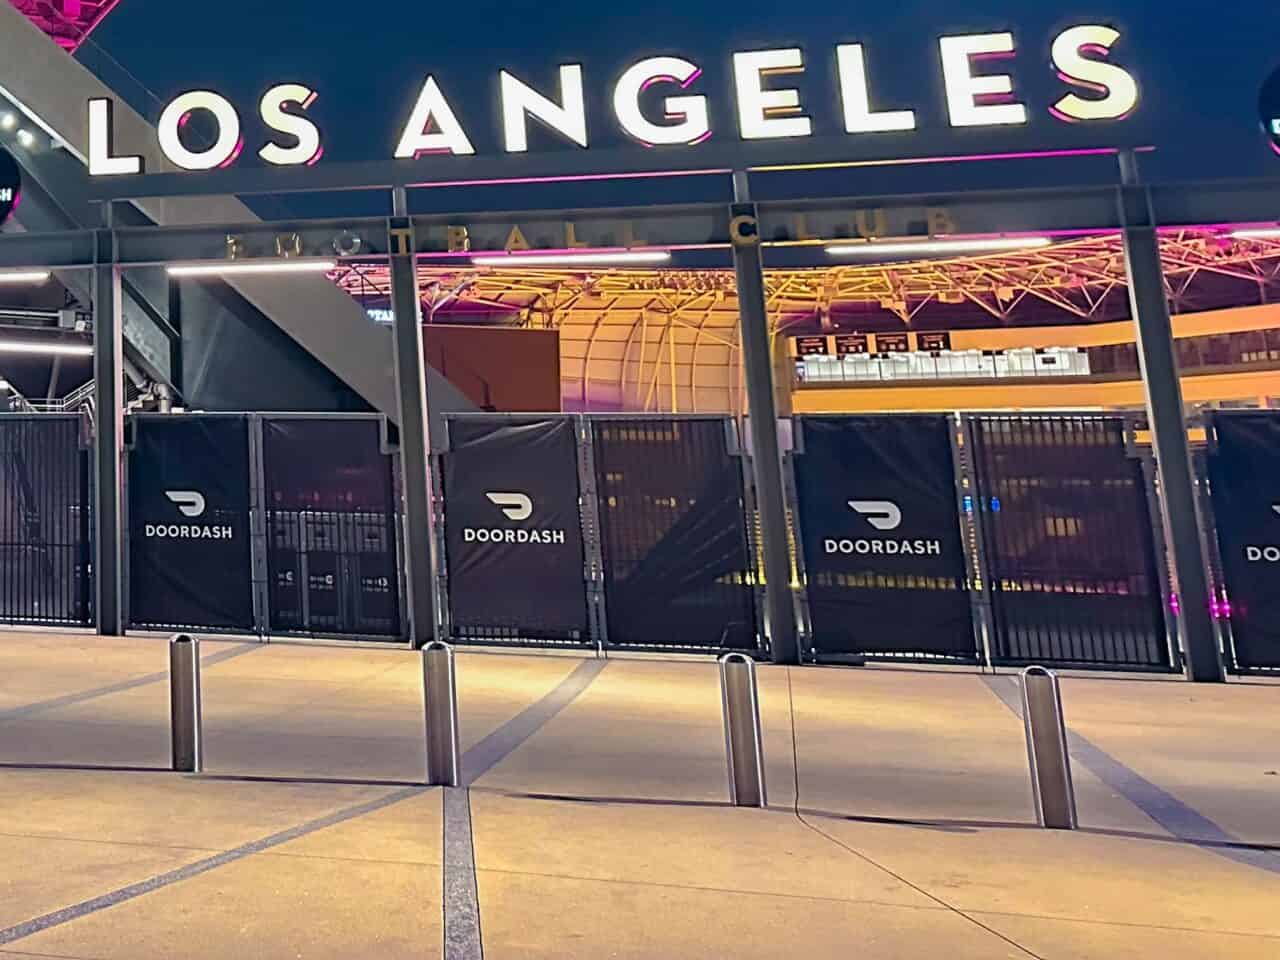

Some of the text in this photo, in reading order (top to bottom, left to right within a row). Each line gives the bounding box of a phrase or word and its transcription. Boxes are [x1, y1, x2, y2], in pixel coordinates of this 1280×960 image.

[87, 23, 1139, 176] LOS ANGELES
[226, 206, 956, 260] FOOTBALL CLUB
[145, 524, 233, 539] DOORDASH
[463, 528, 565, 544] DOORDASH
[824, 539, 941, 555] DOORDASH
[1246, 546, 1280, 562] DO
